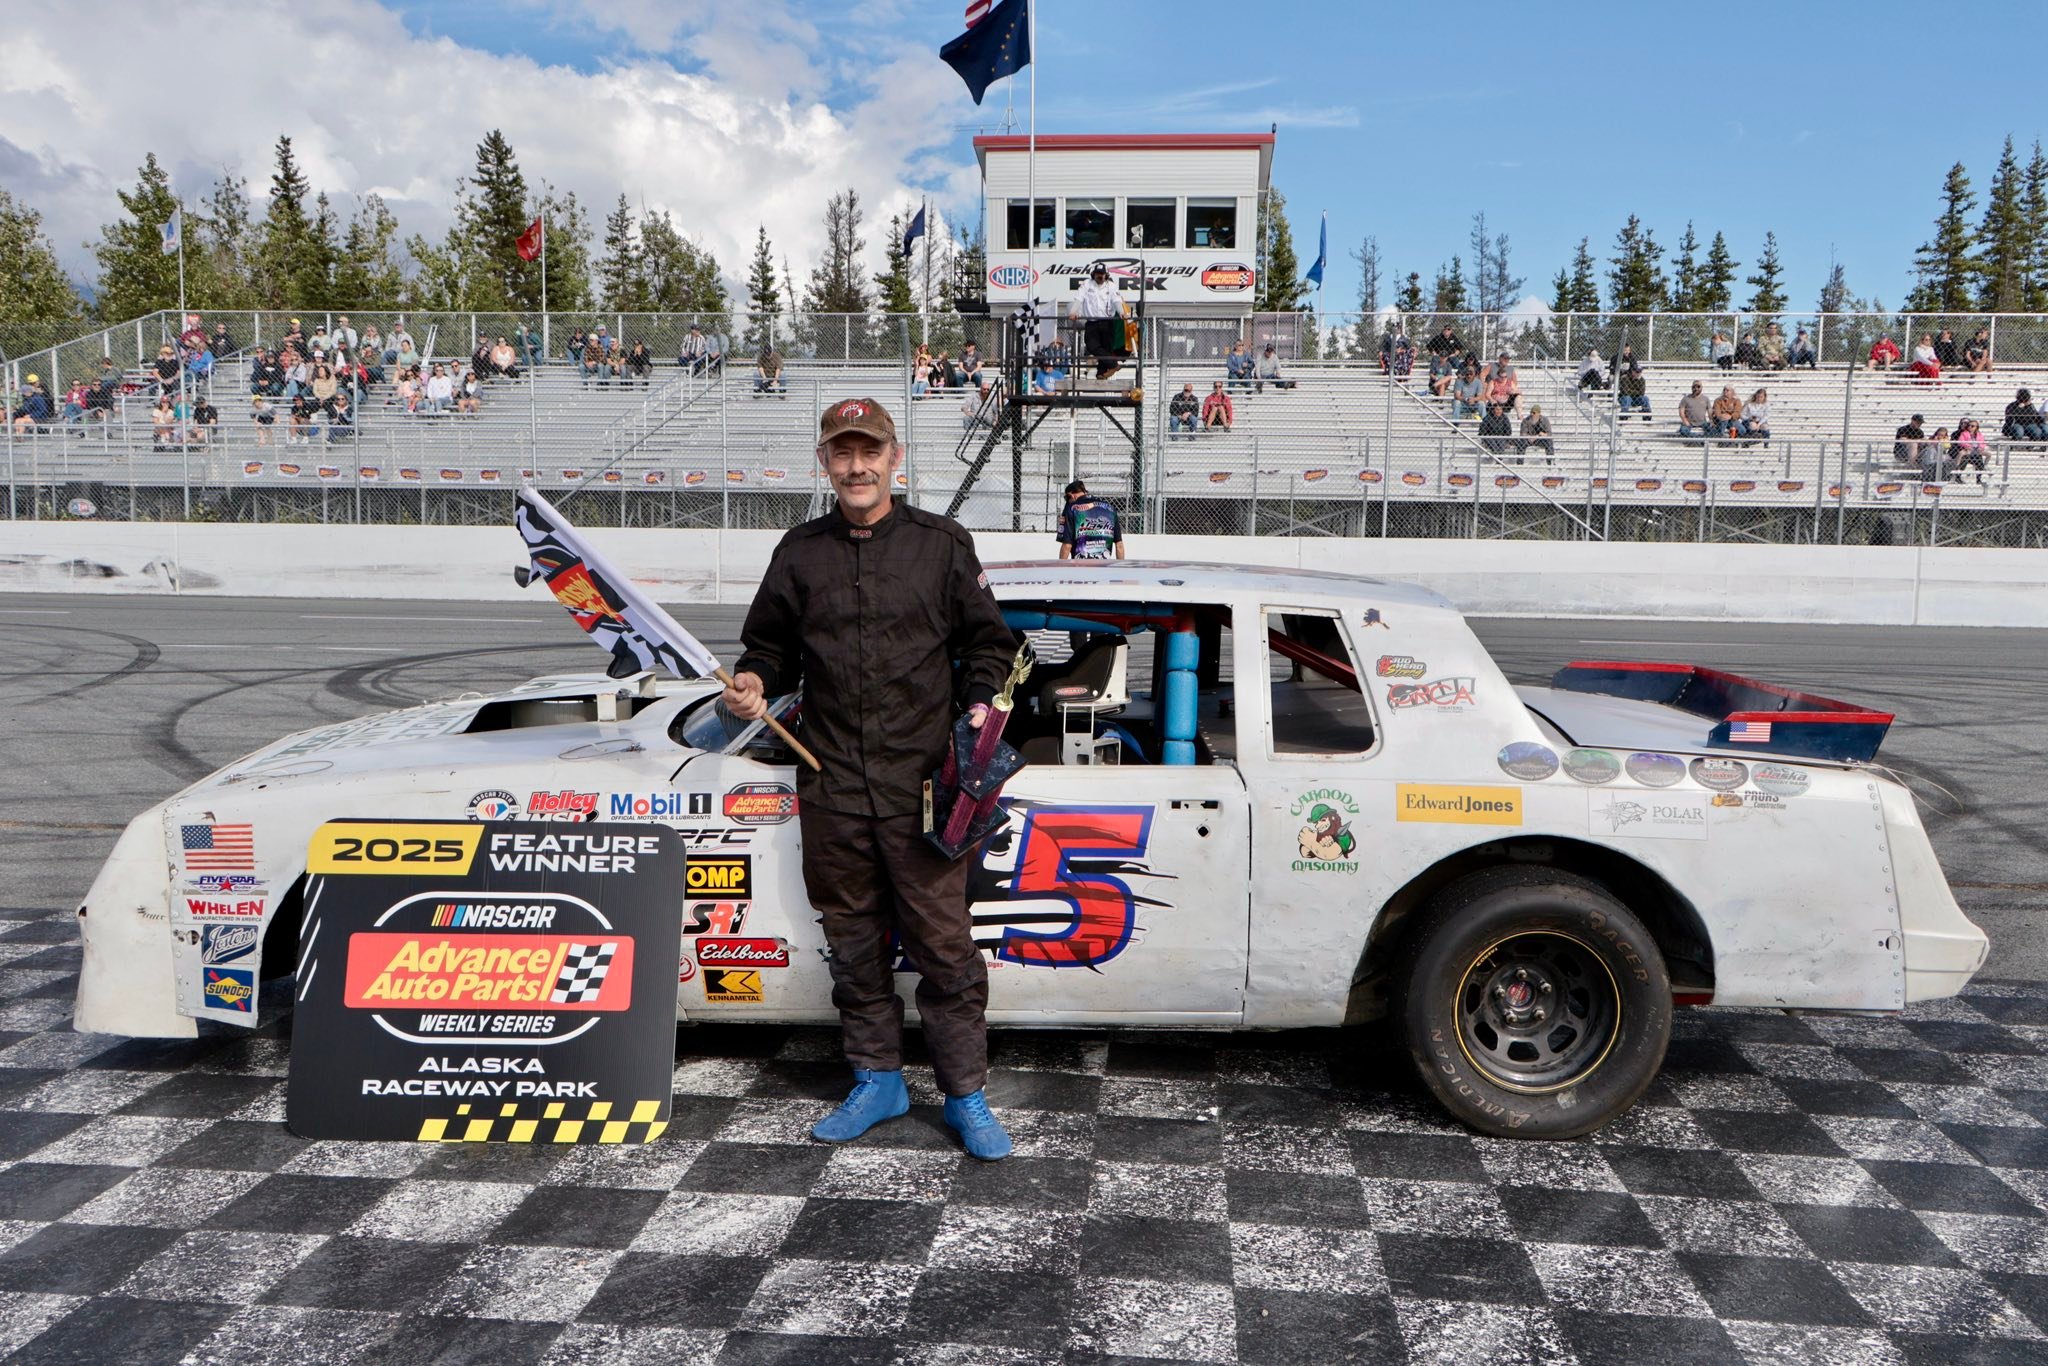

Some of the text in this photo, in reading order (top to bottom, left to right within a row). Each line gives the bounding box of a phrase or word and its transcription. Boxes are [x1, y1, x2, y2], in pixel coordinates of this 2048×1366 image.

[1043, 263, 1096, 276] Alask
[1069, 277, 1168, 291] PRK
[528, 791, 598, 814] Holley
[610, 793, 681, 816] Mobil
[731, 805, 776, 813] Auto Parts
[736, 796, 778, 806] Advance
[1290, 788, 1360, 816] CARMODY
[1405, 794, 1513, 812] Edward Jones
[1652, 806, 1704, 819] POLAR
[332, 838, 464, 862] 2025
[490, 834, 659, 854] FEATURE
[488, 854, 636, 873] WINNER
[1291, 860, 1359, 875] MASONRY
[200, 876, 256, 884] FIVE STAR
[686, 867, 745, 887] OMP
[187, 899, 264, 916] WHELEN
[460, 905, 556, 928] NASCAR
[682, 903, 748, 934] SRI
[202, 924, 257, 963] Jostens
[699, 944, 785, 960] Edelbrock
[1589, 910, 1650, 983] RACER
[386, 941, 550, 974] Advance
[207, 983, 250, 998] SUNOCO
[362, 972, 540, 1002] Auto Parts
[419, 1014, 555, 1033] WEEKLY SERIES
[418, 1057, 545, 1075] ALASKA
[1430, 1028, 1532, 1129] AMERICAN
[361, 1079, 598, 1098] RACEWAY PARK
